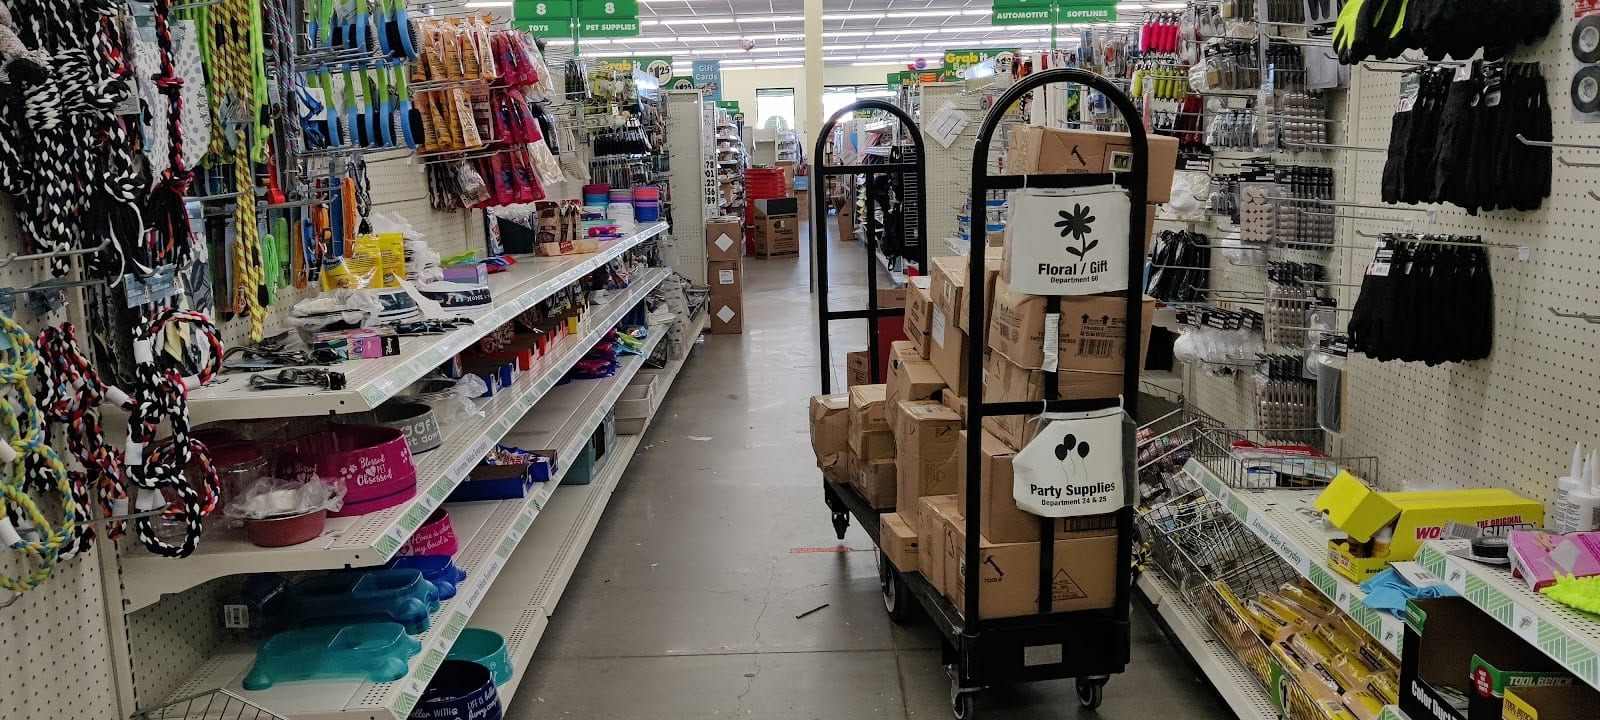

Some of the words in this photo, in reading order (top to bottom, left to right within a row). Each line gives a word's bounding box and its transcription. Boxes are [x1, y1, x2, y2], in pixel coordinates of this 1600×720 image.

[536, 3, 547, 15] 8
[605, 2, 616, 14] 8
[997, 11, 1049, 19] AUTOMOTIVE
[1066, 10, 1108, 18] SOFTLINES
[602, 23, 637, 31] SUPPLIES
[945, 52, 979, 63] Grab
[699, 64, 713, 72] Gift
[695, 73, 718, 81] Cards
[1038, 263, 1077, 275] Floral
[1080, 262, 1086, 275] /
[1090, 260, 1108, 274] Gift
[1050, 276, 1090, 284] Department
[359, 453, 385, 468] Blessed
[357, 468, 392, 486] Obsessed
[1030, 484, 1061, 499] Party
[1066, 482, 1115, 497] Supplies
[1041, 498, 1081, 507] Department
[1476, 520, 1489, 528] THE
[1490, 515, 1522, 526] ORIGINAL
[1252, 518, 1270, 537] Extreme
[1269, 532, 1281, 547] Value
[1280, 541, 1303, 566] Everyday
[1509, 676, 1536, 686] TOOL
[1411, 680, 1432, 710] Color
